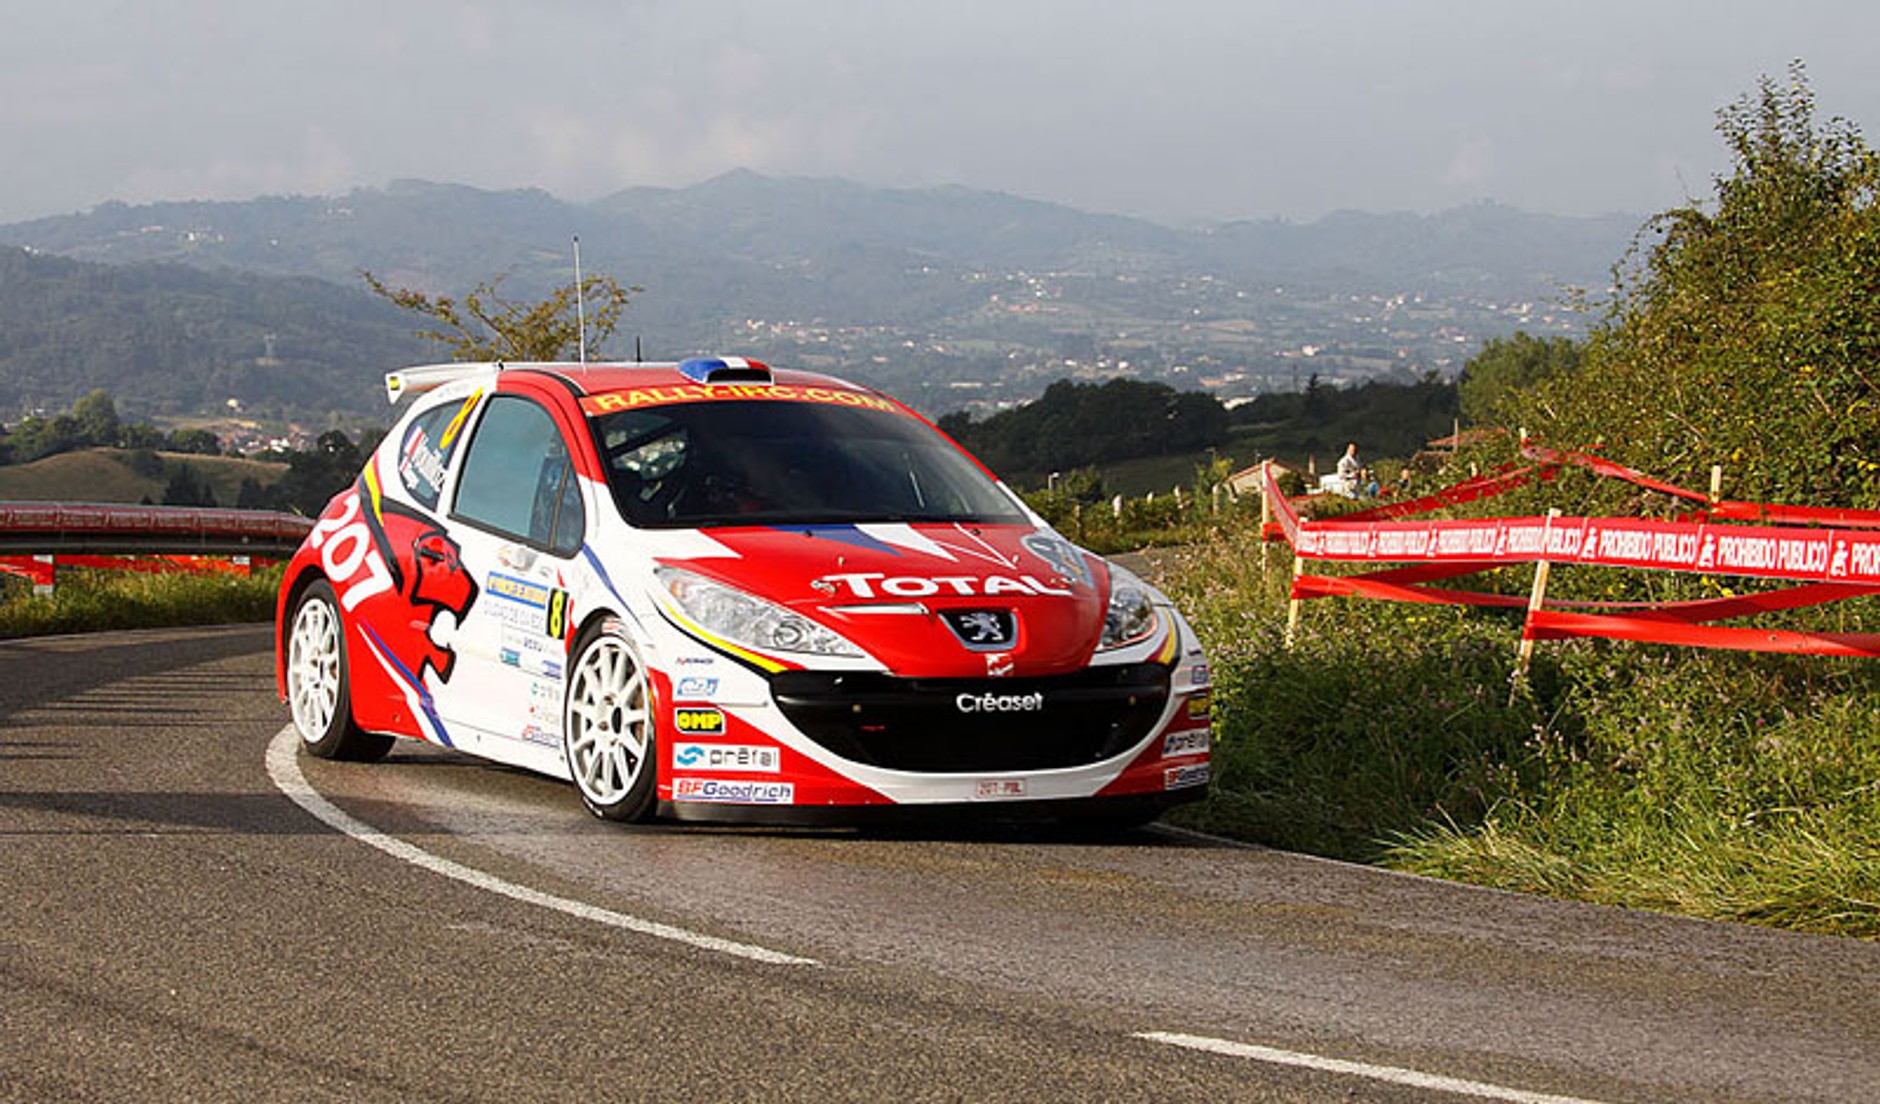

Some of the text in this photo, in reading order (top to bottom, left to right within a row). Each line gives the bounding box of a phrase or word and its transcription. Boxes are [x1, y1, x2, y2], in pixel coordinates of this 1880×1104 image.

[312, 493, 393, 613] 207
[1599, 529, 1651, 560] PROHIBIDO
[1652, 533, 1698, 564] PUBLICO
[1717, 536, 1777, 569] PROHIBIDO
[1776, 539, 1828, 572] PUBLICO
[823, 573, 1073, 598] TOTAL
[549, 588, 566, 641] 8
[956, 692, 1043, 713] Créaset
[677, 711, 722, 730] OMP
[677, 780, 791, 798] BFGoodrich
